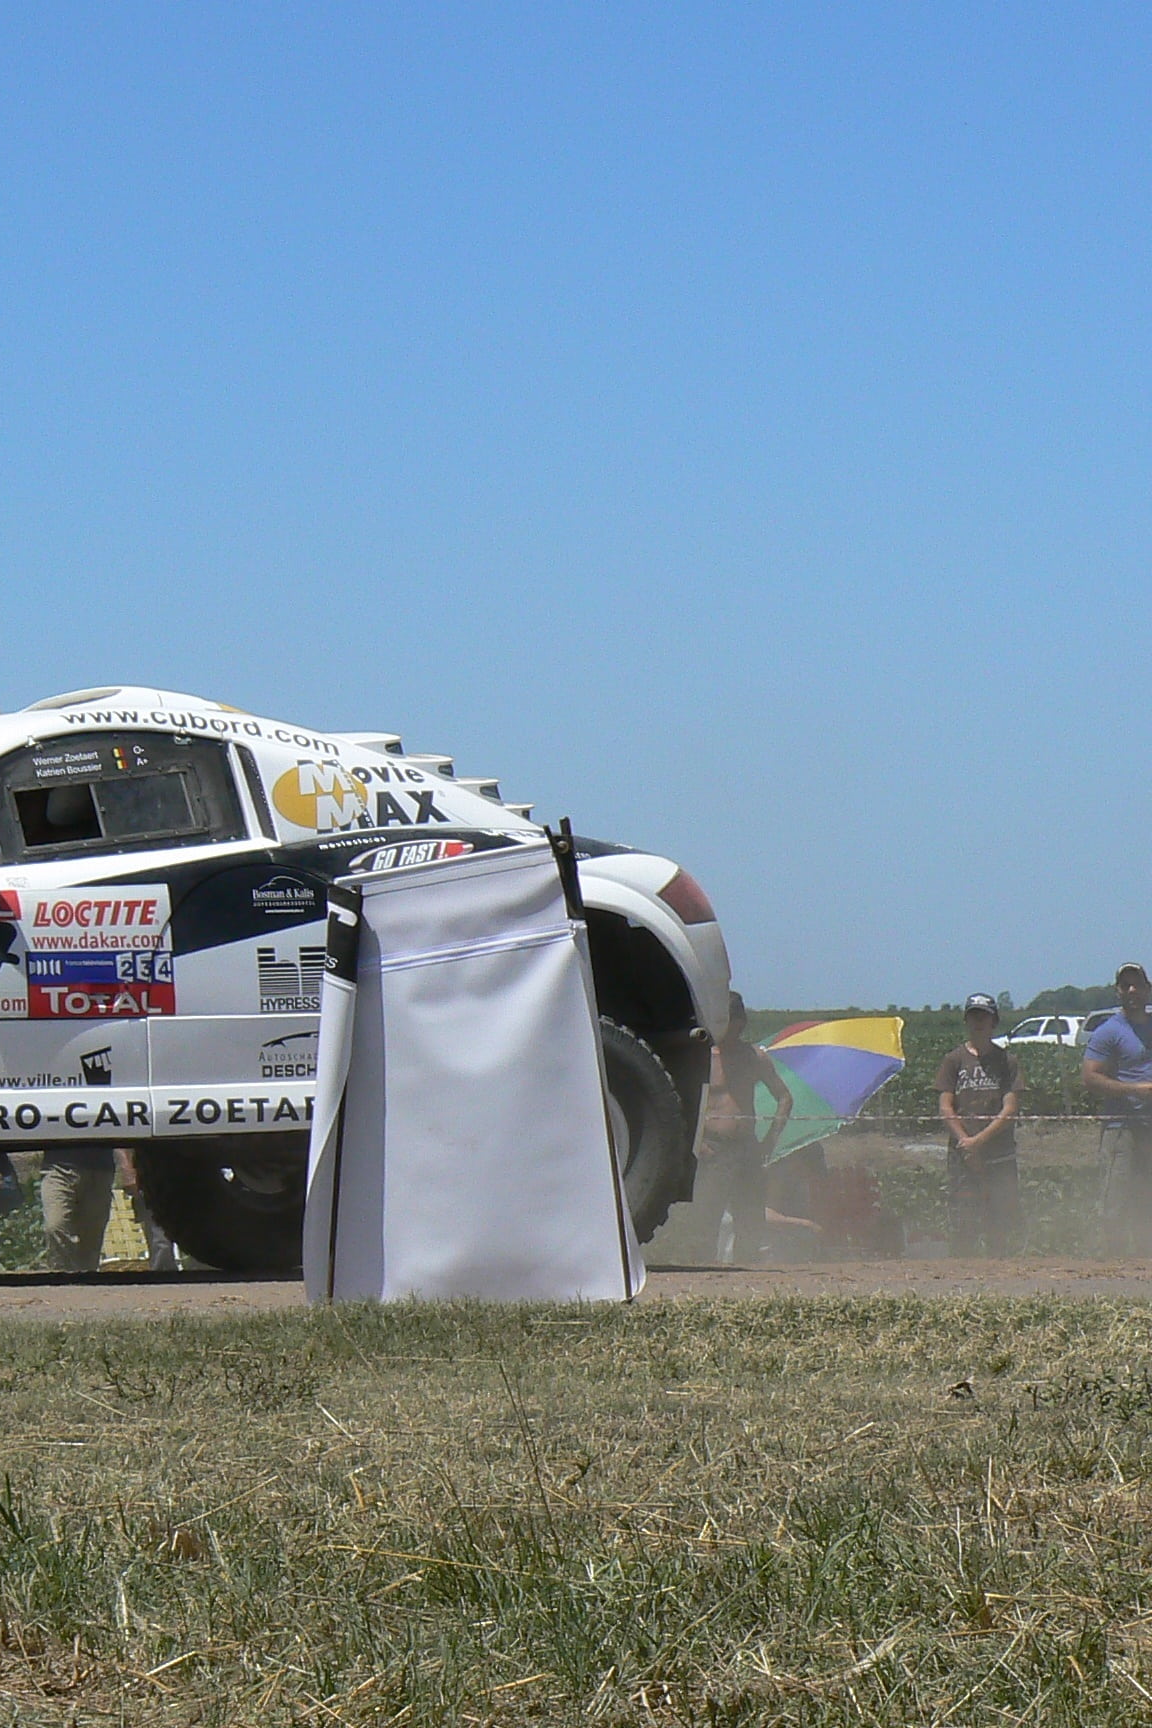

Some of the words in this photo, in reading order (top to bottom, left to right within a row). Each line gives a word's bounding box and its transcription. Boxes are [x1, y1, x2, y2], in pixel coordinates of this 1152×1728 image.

[60, 710, 340, 756] www.cubord.com
[372, 848, 398, 871] GO
[399, 842, 438, 866] FAST
[32, 899, 159, 928] LOCTITE
[31, 931, 165, 949] www.dakar.com
[41, 986, 163, 1015] TOTAL
[260, 996, 320, 1010] HYPRESS
